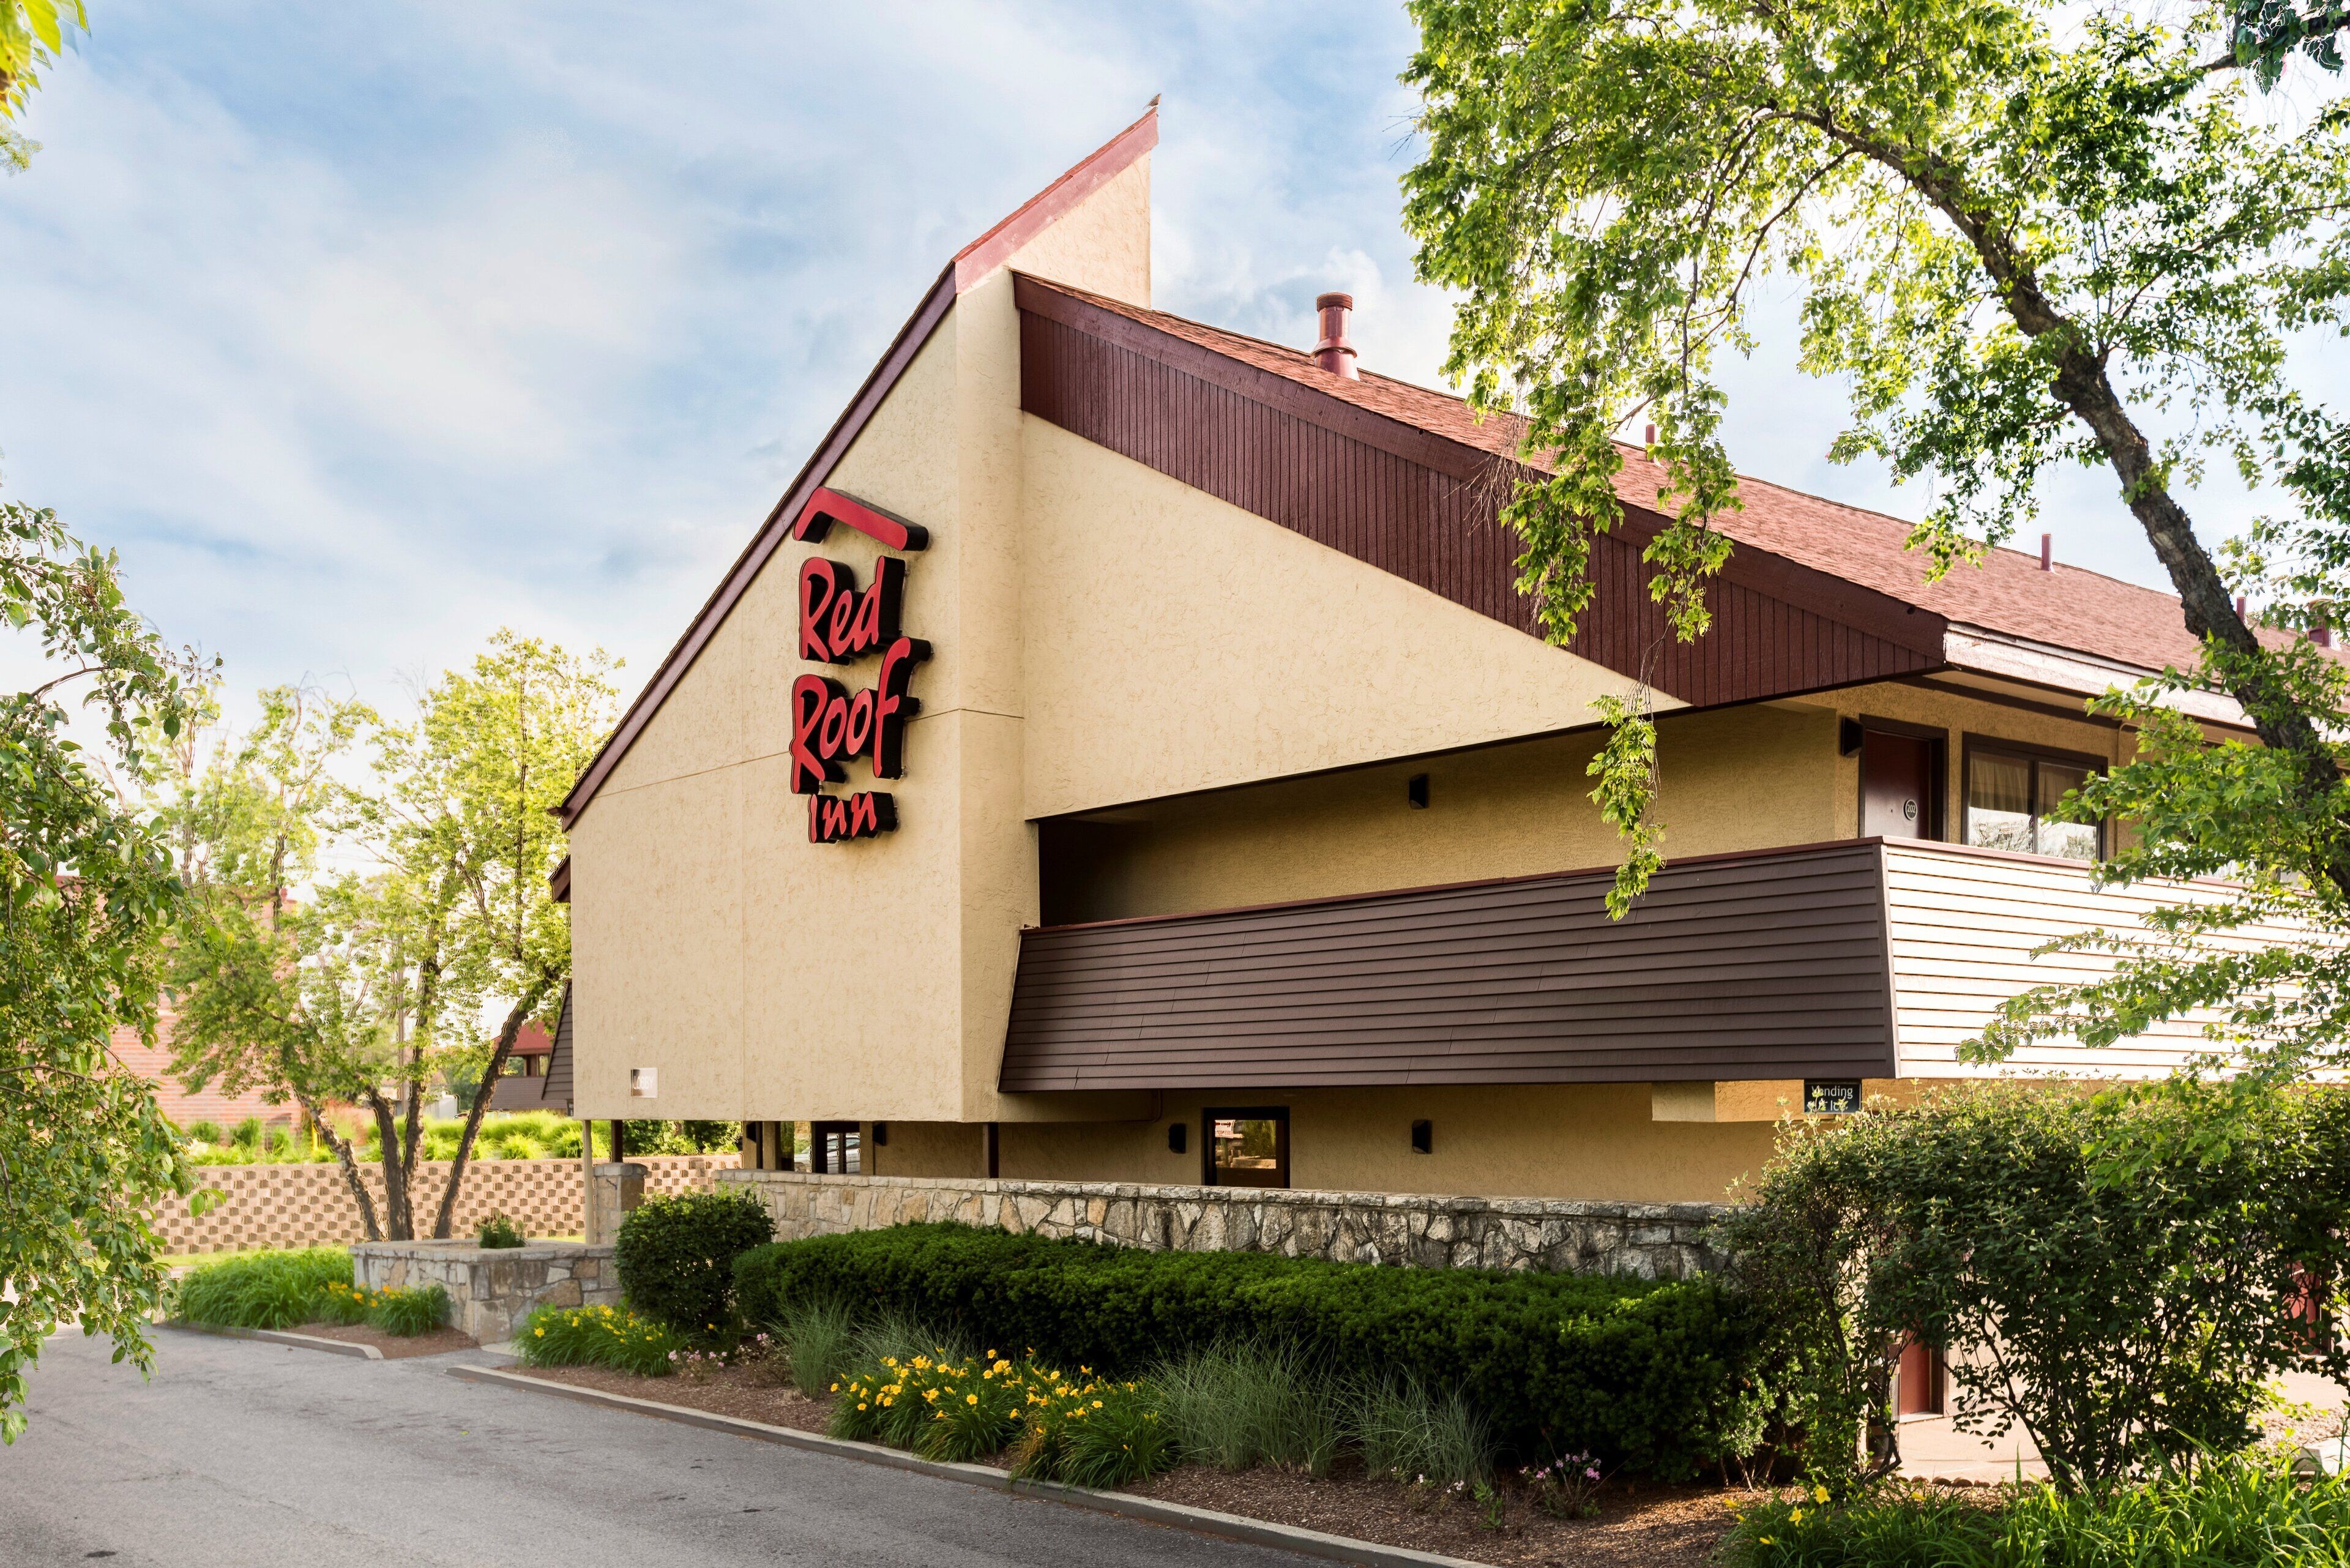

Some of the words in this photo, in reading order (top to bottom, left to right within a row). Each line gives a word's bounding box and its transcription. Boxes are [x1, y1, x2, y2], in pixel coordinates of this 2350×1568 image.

[799, 555, 885, 663] Red
[790, 636, 912, 794] Roof
[1907, 804, 1915, 813] 202
[1830, 1100, 1846, 1111] Ic
